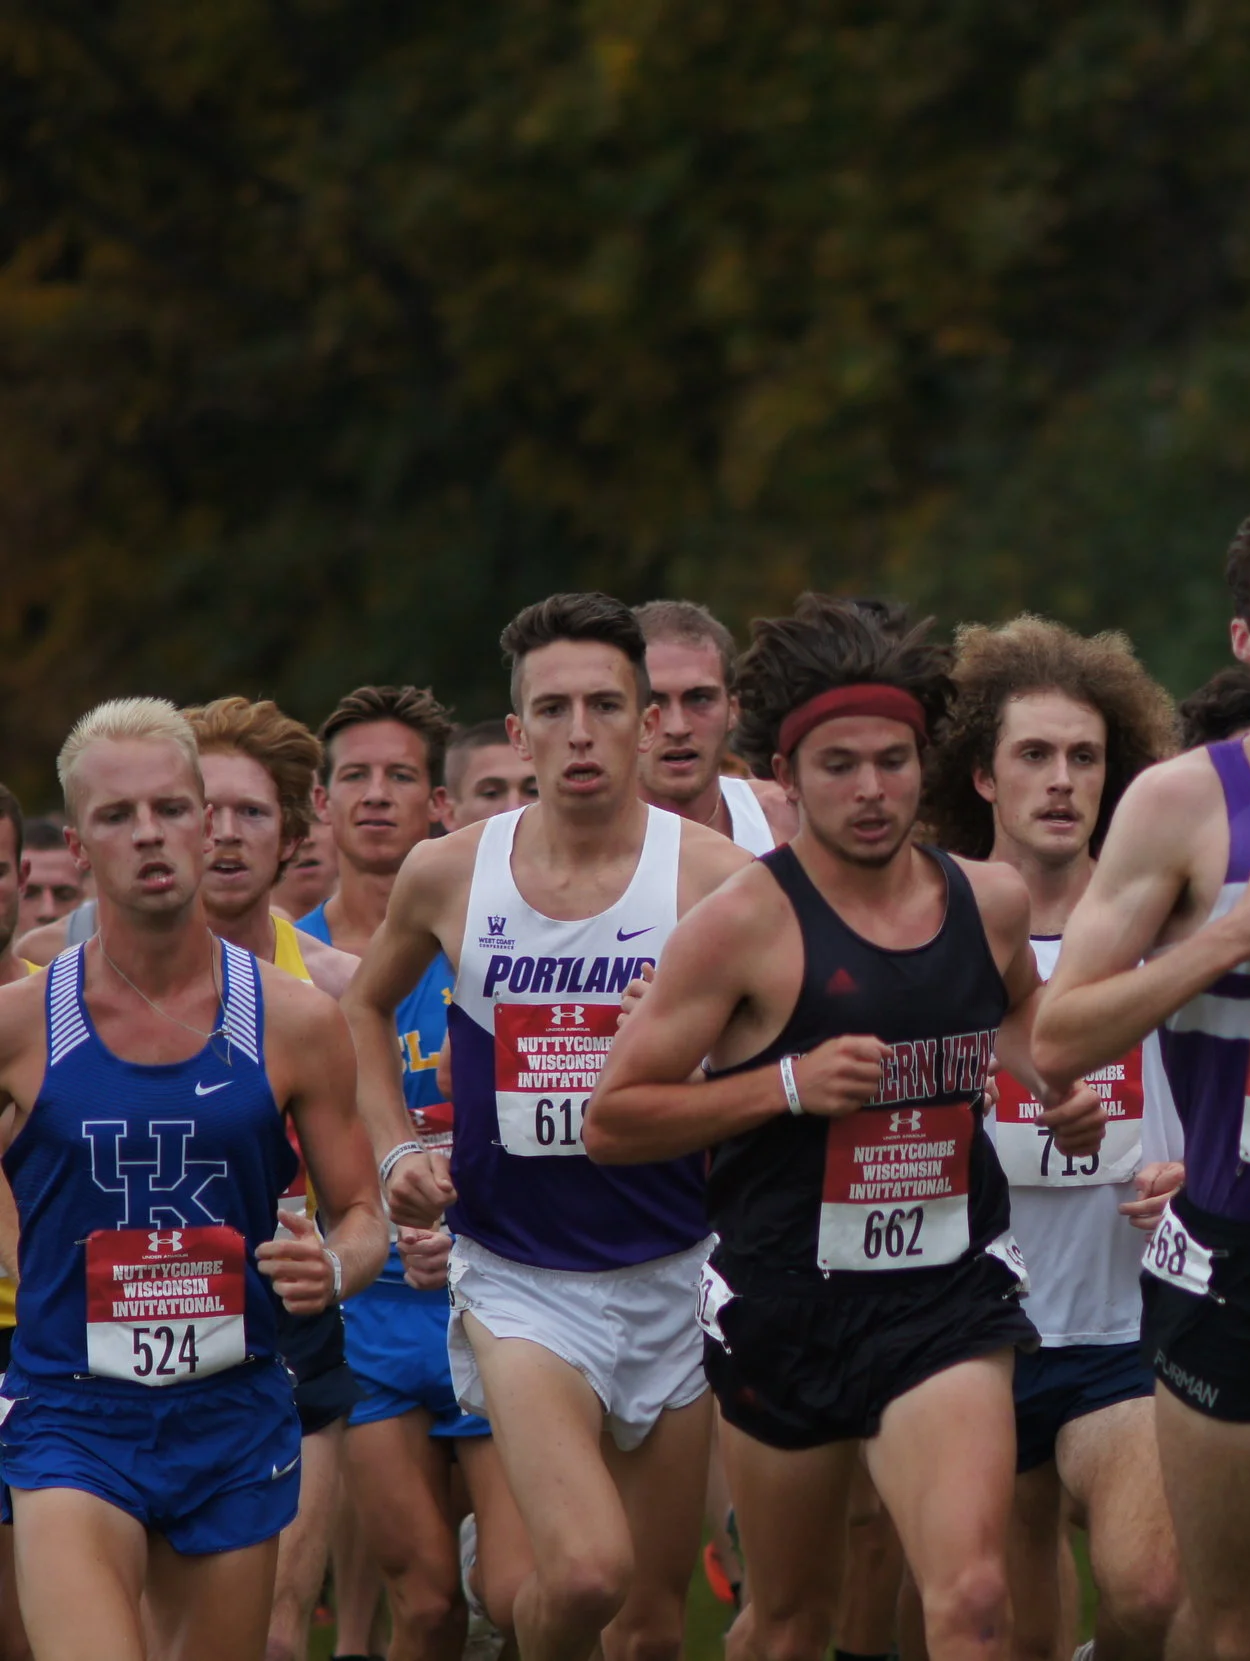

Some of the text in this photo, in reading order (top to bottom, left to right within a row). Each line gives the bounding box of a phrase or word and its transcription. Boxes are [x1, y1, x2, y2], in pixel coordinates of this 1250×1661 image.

[478, 936, 516, 946] WEST COAST
[478, 943, 514, 951] CONFERENCE
[517, 1071, 600, 1089] INVITATIO
[534, 1098, 593, 1147] 61
[853, 1139, 957, 1164] NUTTYCOMBE
[82, 1119, 228, 1231] UK
[862, 1159, 943, 1182] WISCONSIN
[848, 1177, 953, 1200] INVITATIONAL
[863, 1206, 925, 1260] 662
[112, 1259, 224, 1282] NUTTYCOMBE
[122, 1277, 209, 1299] WISCONSIN
[112, 1295, 226, 1319] INVITATIONAL
[132, 1324, 200, 1378] 524
[1153, 1348, 1221, 1410] FURMAN
